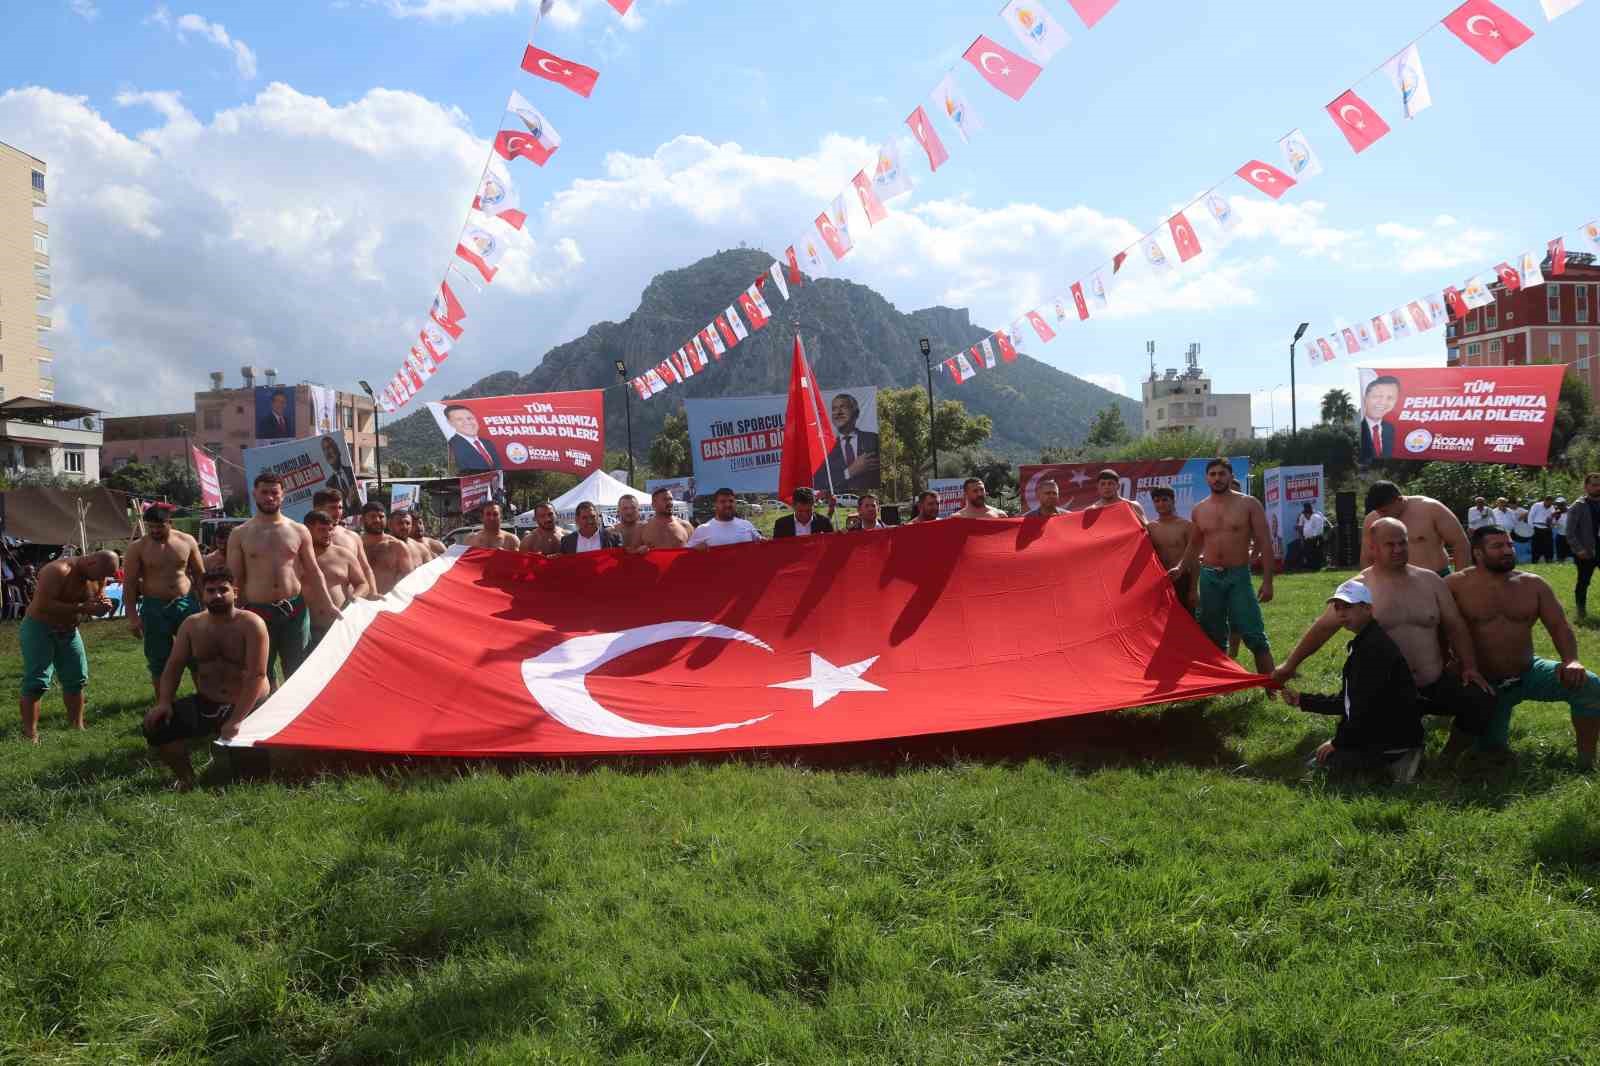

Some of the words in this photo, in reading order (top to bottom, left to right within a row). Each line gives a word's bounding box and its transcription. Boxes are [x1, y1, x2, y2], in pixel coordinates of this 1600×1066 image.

[1463, 380, 1496, 393] TÜM
[523, 402, 553, 413] TÜM
[1398, 410, 1483, 423] BAŞARILAR
[1484, 409, 1546, 422] DİLERİZ
[710, 421, 734, 437] TÜM
[737, 413, 784, 433] SPORCUL
[488, 426, 557, 436] BAŞARILAR
[558, 427, 599, 441] DİLERİZ
[1432, 437, 1474, 446] KOZAN
[755, 451, 784, 466] KARAL
